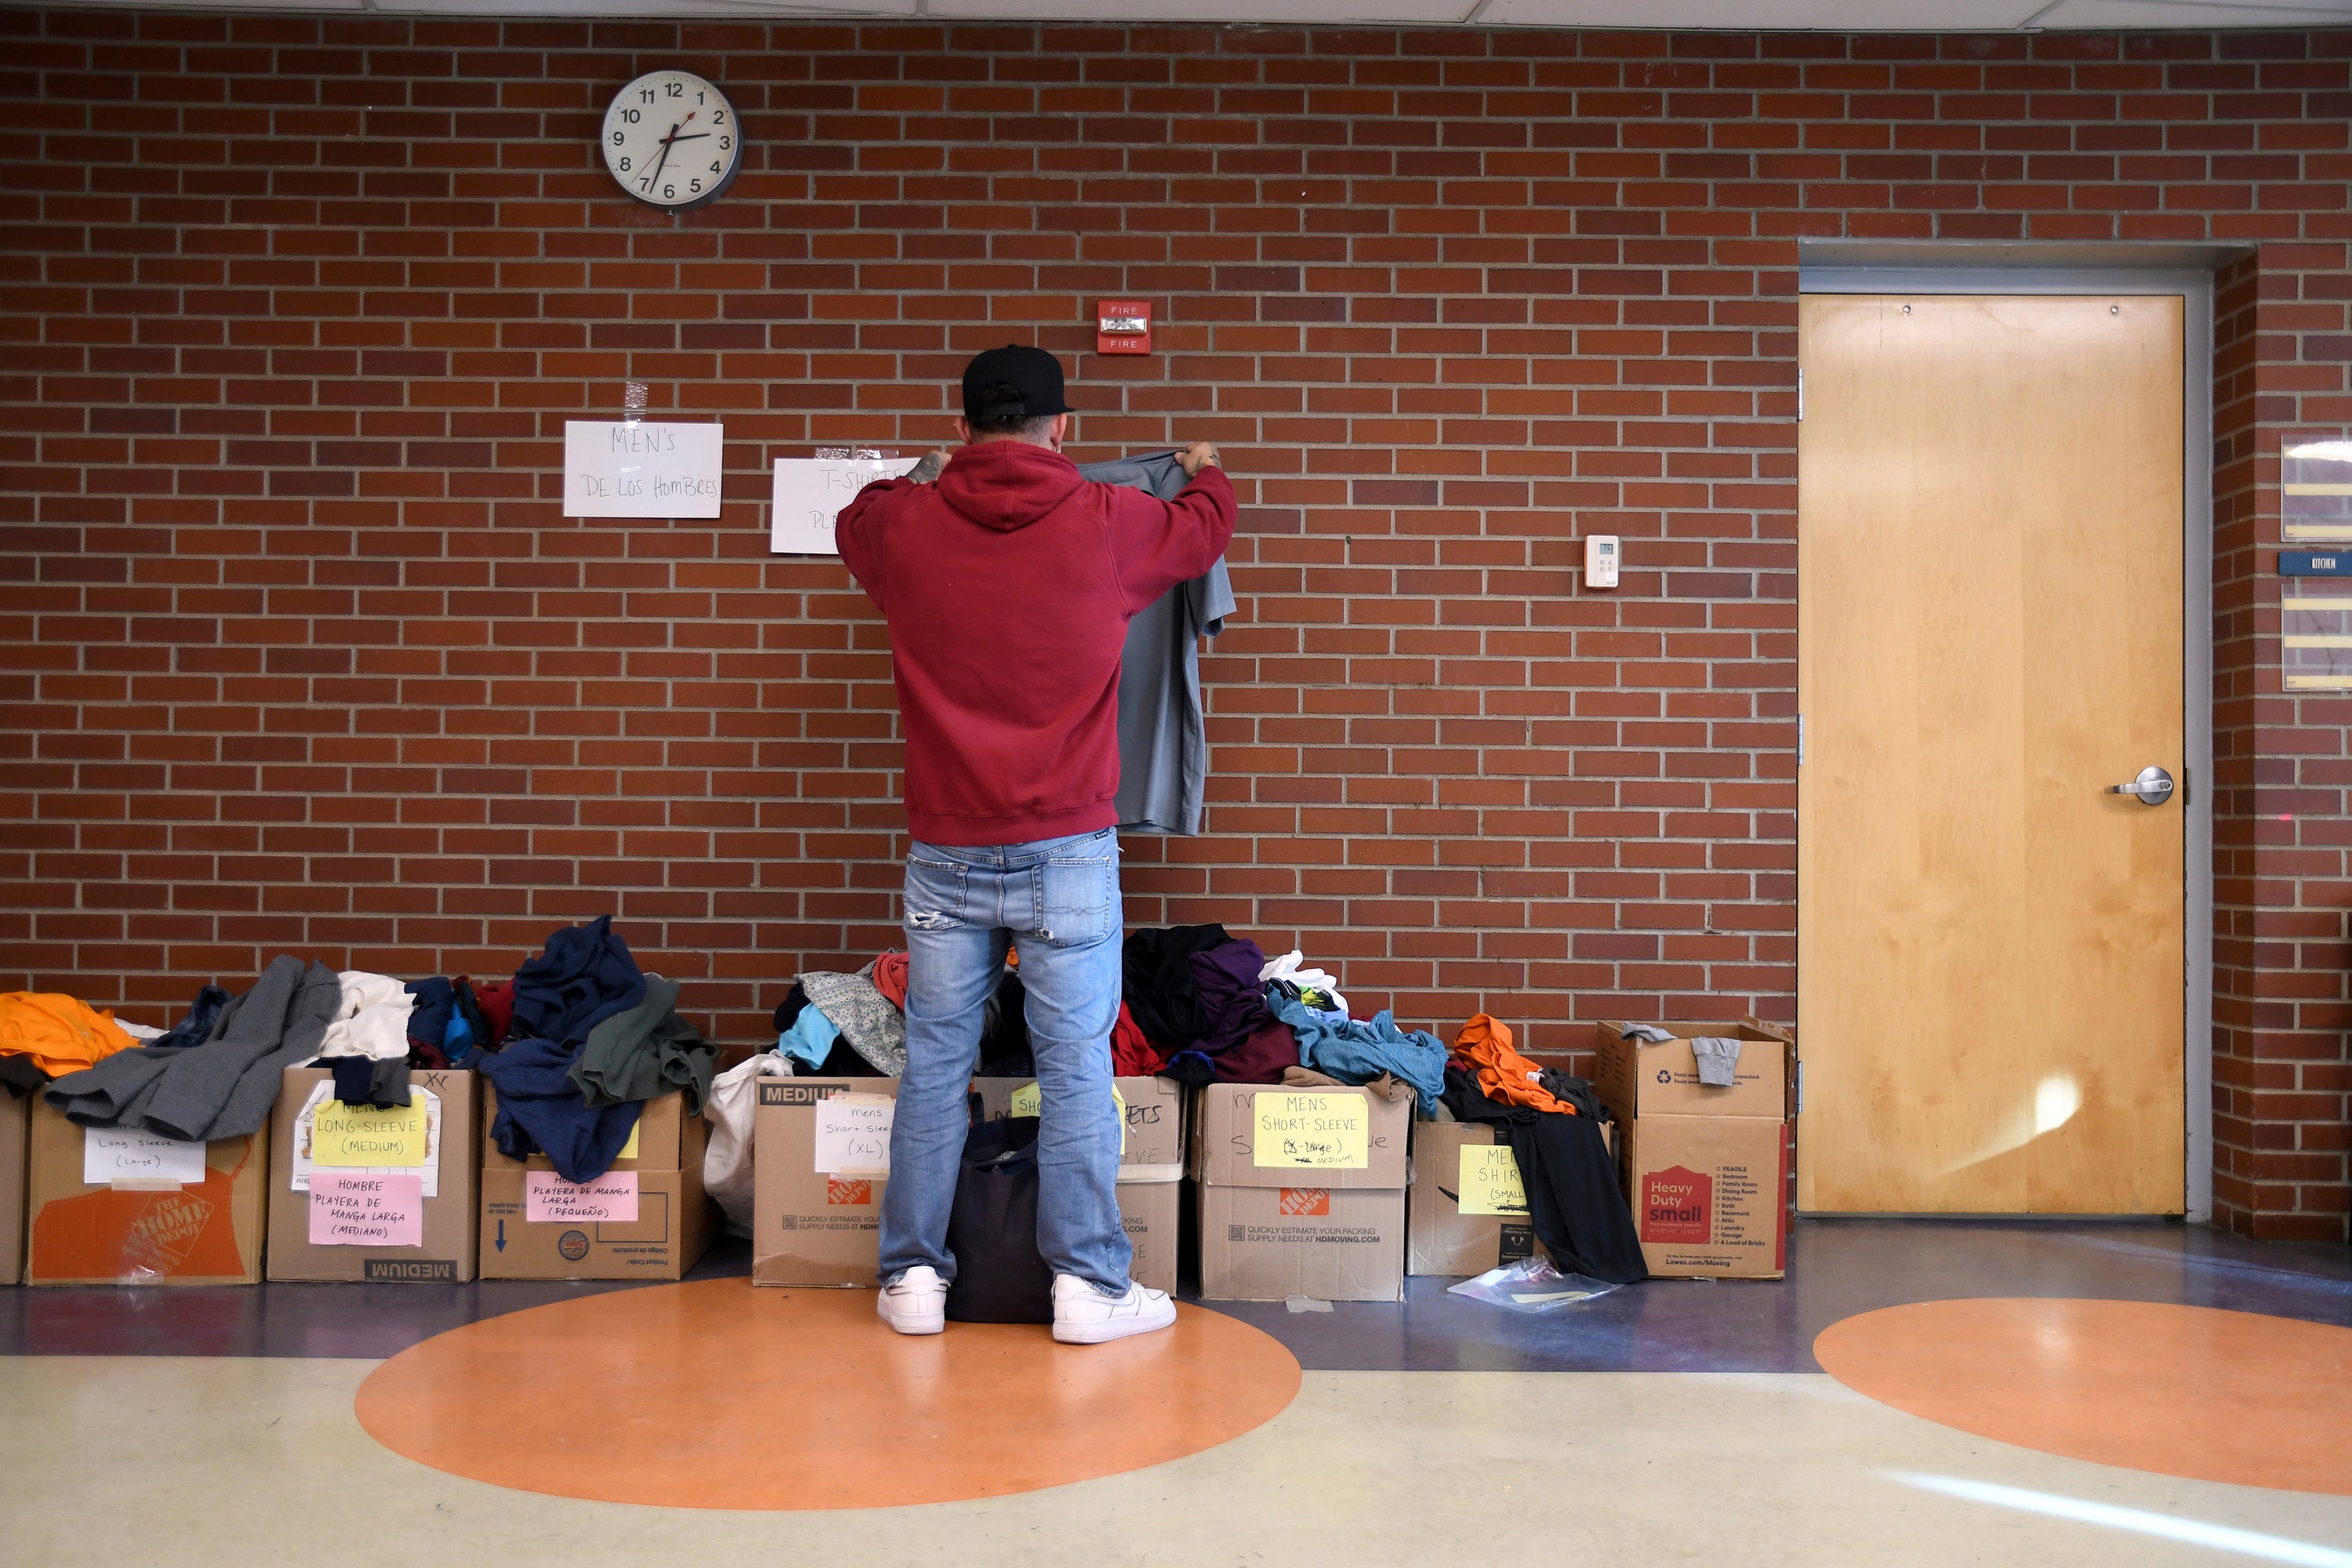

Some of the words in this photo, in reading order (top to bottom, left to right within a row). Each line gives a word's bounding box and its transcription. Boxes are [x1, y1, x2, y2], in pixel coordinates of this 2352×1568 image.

[640, 90, 655, 103] 11
[665, 83, 683, 97] 12
[697, 92, 704, 105] 1
[621, 109, 641, 124] 10
[713, 111, 724, 124] 2
[613, 132, 624, 146] 9
[720, 136, 730, 150] 3
[620, 157, 631, 171] 8
[710, 161, 721, 174] 4
[640, 177, 650, 191] 7
[664, 184, 675, 198] 6
[690, 179, 701, 193] 5
[612, 427, 676, 454] MEN'S
[582, 474, 610, 497] DE
[619, 477, 643, 497] LOS
[810, 511, 838, 529] PLA
[2311, 557, 2336, 569] KITCHEN
[1287, 1096, 1327, 1112] MENS
[318, 1118, 418, 1134] LONG-SLEEVE
[1261, 1115, 1358, 1131] SHORT-SLEEVE
[99, 1138, 128, 1149] Long
[342, 1137, 404, 1155] (MEDIUM)
[848, 1138, 884, 1160] (XL)
[1479, 1167, 1518, 1182] SHIR
[339, 1179, 384, 1192] HOMBRE
[533, 1186, 575, 1195] PLAYERA
[594, 1187, 630, 1196] MANGA
[1651, 1181, 1693, 1196] Heavy
[315, 1194, 359, 1207] PLAYERA
[367, 1197, 381, 1207] DE
[543, 1196, 576, 1206] LARGA
[1651, 1194, 1682, 1207] Duty
[133, 1200, 209, 1237] HOME
[331, 1210, 366, 1221] MANGA
[372, 1211, 405, 1221] LARGA
[549, 1205, 609, 1218] (PEQUEÑO)
[1650, 1206, 1701, 1221] small
[332, 1226, 388, 1239] (MEDIANO)
[372, 1264, 449, 1277] MEDIUM
[1666, 1259, 1730, 1268] Lowes.com/Moving
